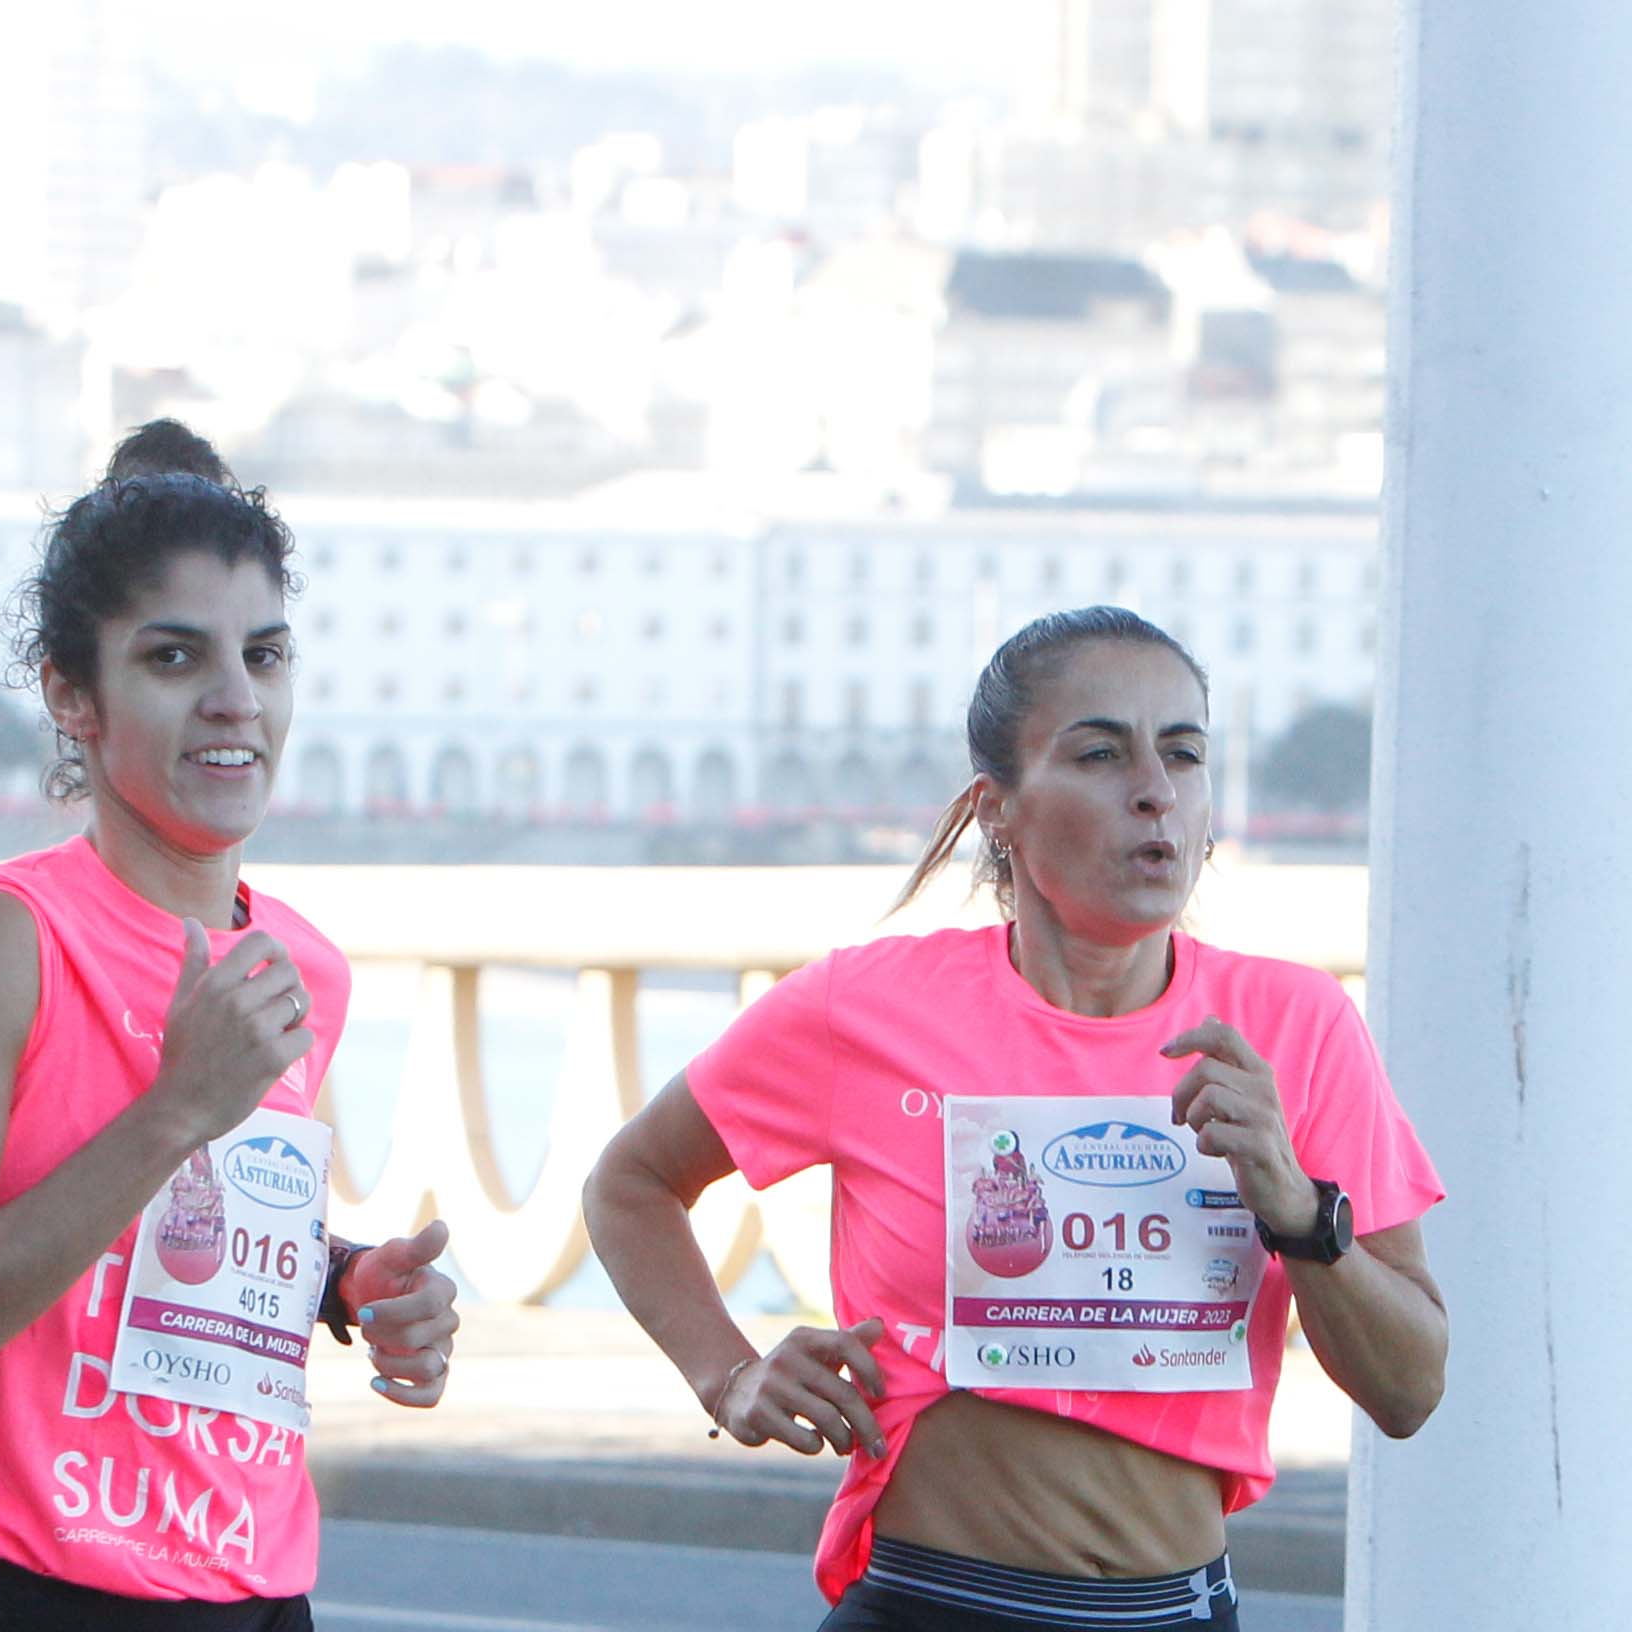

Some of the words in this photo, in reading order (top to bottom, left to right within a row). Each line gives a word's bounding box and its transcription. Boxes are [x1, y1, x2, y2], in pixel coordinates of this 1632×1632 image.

[1054, 1145, 1176, 1171] ASTURIANA
[232, 1154, 310, 1198] ASTURIANA
[1062, 1212, 1172, 1252] 016
[232, 1227, 299, 1280] 016
[1102, 1267, 1134, 1291] 18
[239, 1286, 280, 1319] 4015
[985, 1305, 1075, 1322] CARRERA
[1079, 1306, 1106, 1322] DE
[1110, 1307, 1135, 1323] LA
[1139, 1308, 1199, 1325] MUJER
[1201, 1309, 1231, 1325] 2023
[160, 1311, 234, 1340] CARRERA
[235, 1326, 249, 1343] DE
[249, 1329, 264, 1348] LA
[266, 1335, 302, 1358] MUJER
[143, 1349, 232, 1385] OYSHO
[1159, 1348, 1227, 1367] Santander
[52, 1451, 256, 1565] SUMA
[148, 1546, 168, 1562] LA
